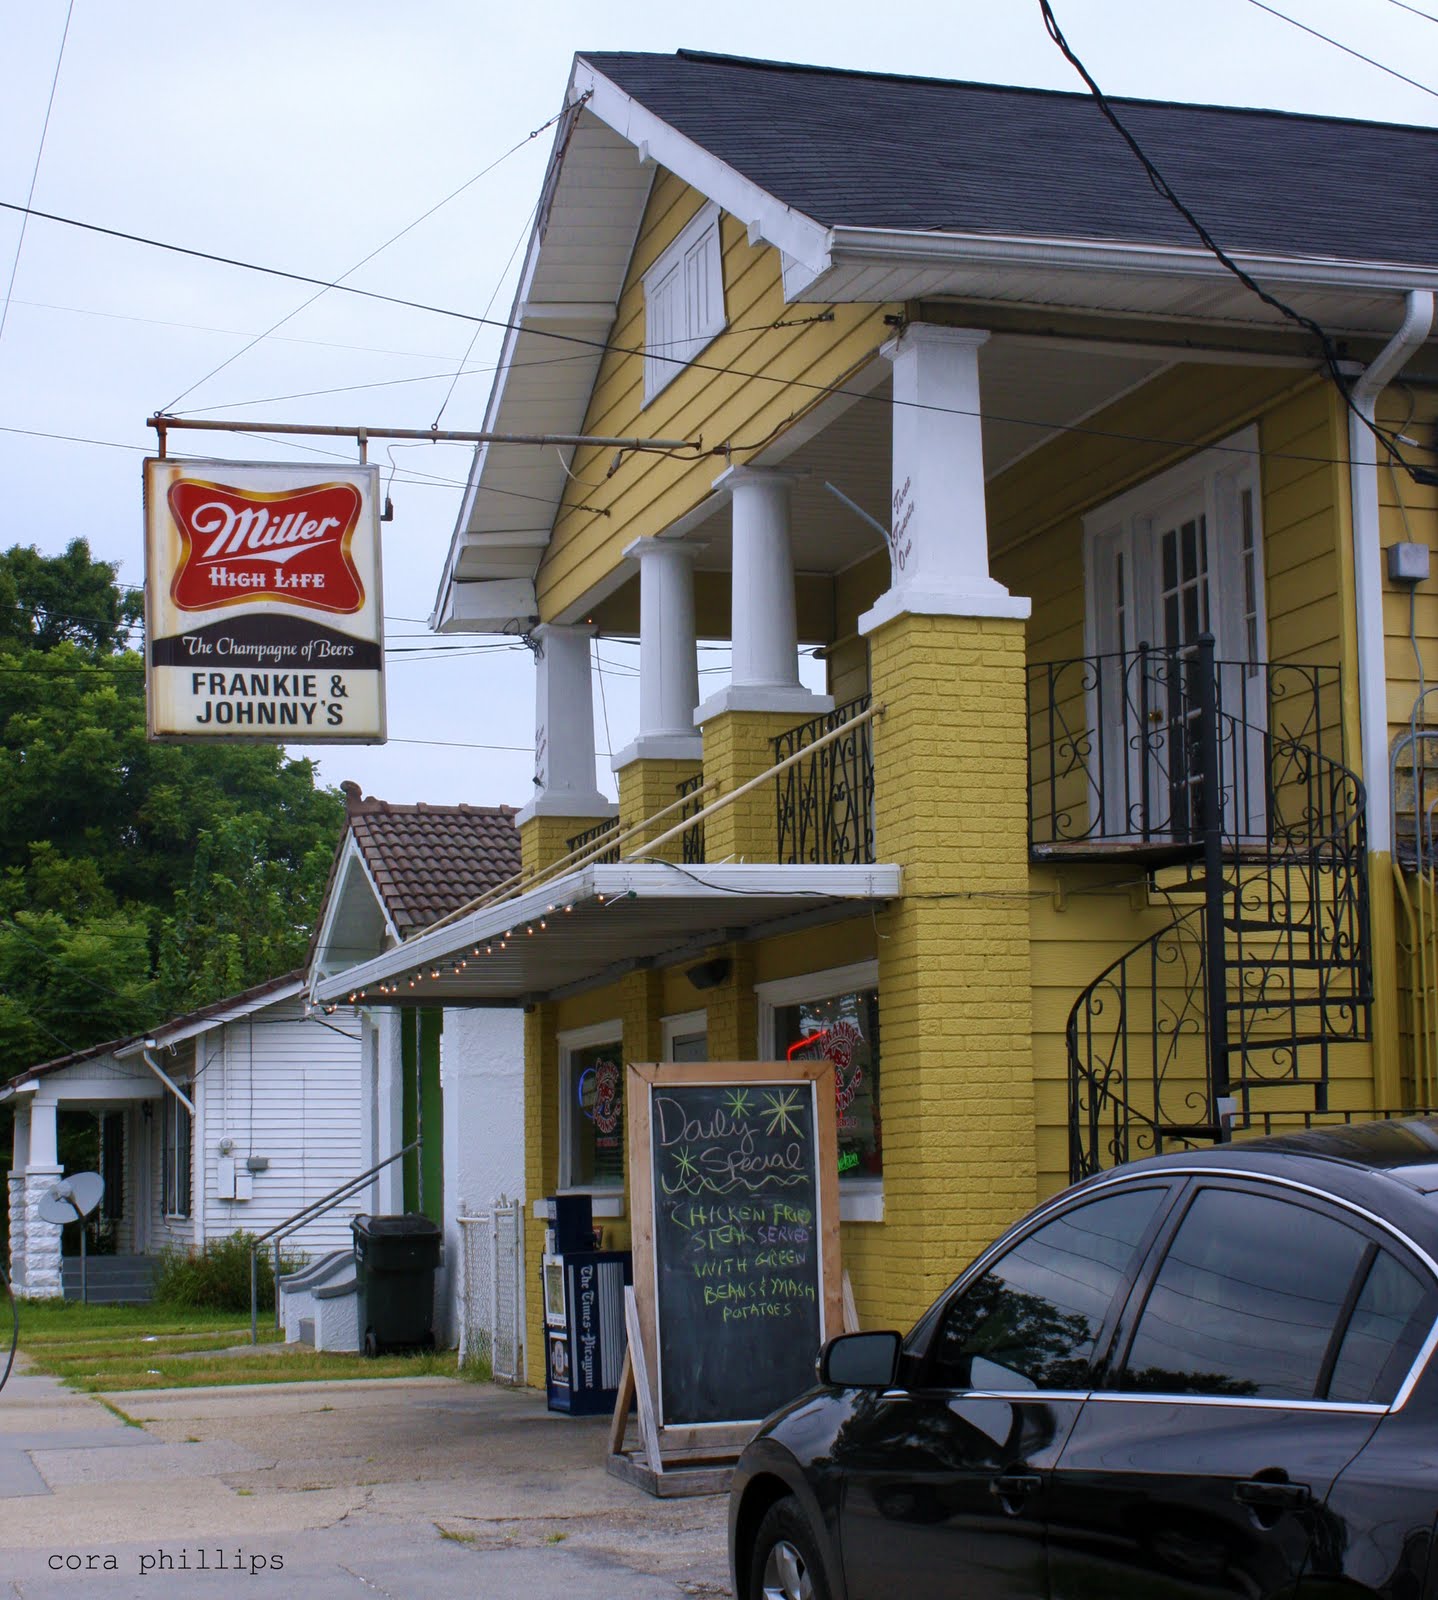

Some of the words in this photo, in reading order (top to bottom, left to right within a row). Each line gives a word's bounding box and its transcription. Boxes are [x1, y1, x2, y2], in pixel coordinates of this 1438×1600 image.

[191, 502, 341, 558] Miller
[208, 566, 266, 587] HIGH
[274, 568, 325, 588] LIFE
[182, 636, 213, 656] The
[216, 637, 297, 662] Champagne
[301, 640, 315, 664] of
[314, 640, 354, 658] Beers
[192, 673, 317, 697] FRANKIE
[330, 674, 349, 698] &
[196, 700, 343, 726] JOHNNY'S
[654, 1097, 759, 1154] Daily
[700, 1142, 805, 1180] Special
[671, 1202, 766, 1230] CHICKEN
[691, 1224, 756, 1252] STEAK
[757, 1226, 809, 1243] SERVED
[580, 1264, 594, 1289] The
[693, 1258, 748, 1278] WITH
[754, 1248, 806, 1267] GREEN
[704, 1282, 757, 1305] BEANS
[771, 1278, 815, 1302] MASH
[723, 1303, 792, 1323] POTATOES
[580, 1290, 596, 1388] Times-Picayune
